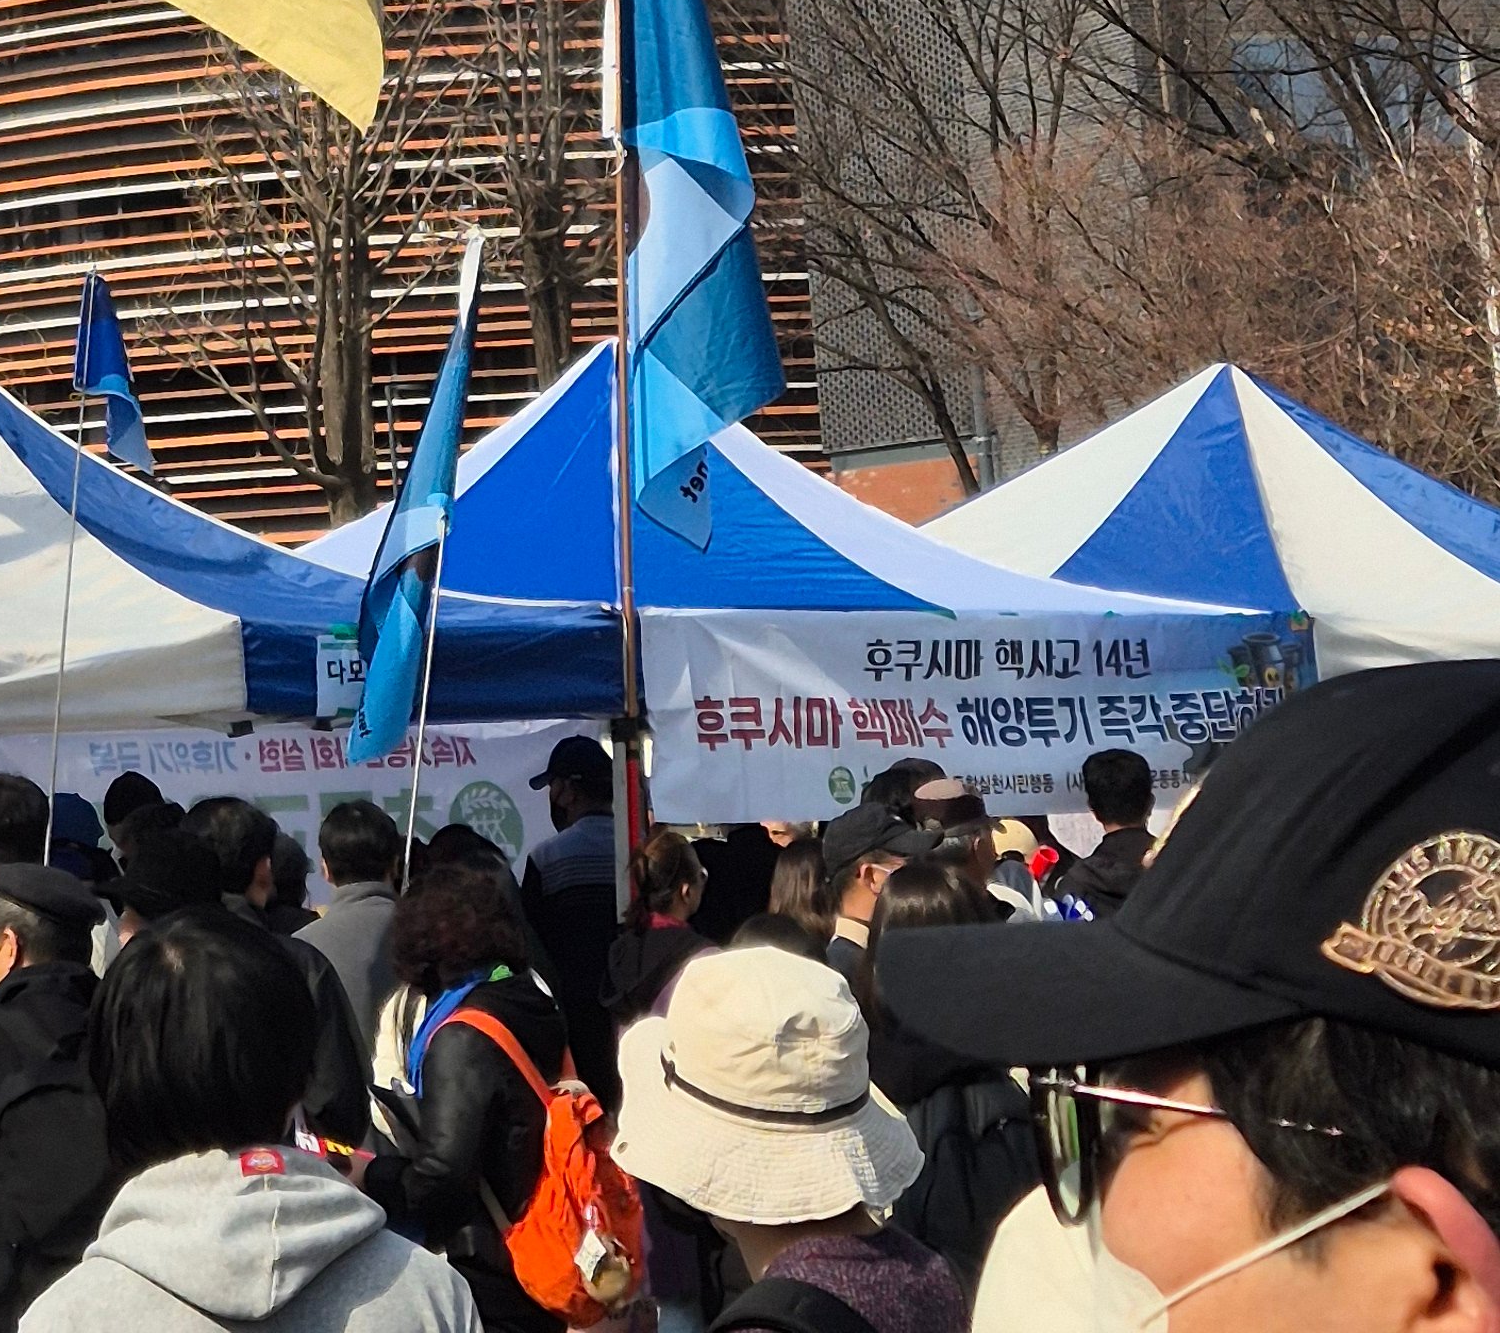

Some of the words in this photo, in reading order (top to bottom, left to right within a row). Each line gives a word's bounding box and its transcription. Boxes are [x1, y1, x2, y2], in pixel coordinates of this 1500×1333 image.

[863, 639, 984, 681] 후쿠시마
[995, 638, 1082, 680] 핵사고
[1093, 637, 1151, 679] 14년
[694, 696, 844, 751] 후쿠시마
[956, 696, 1095, 747] 해양투기
[1097, 694, 1171, 744] 즉각
